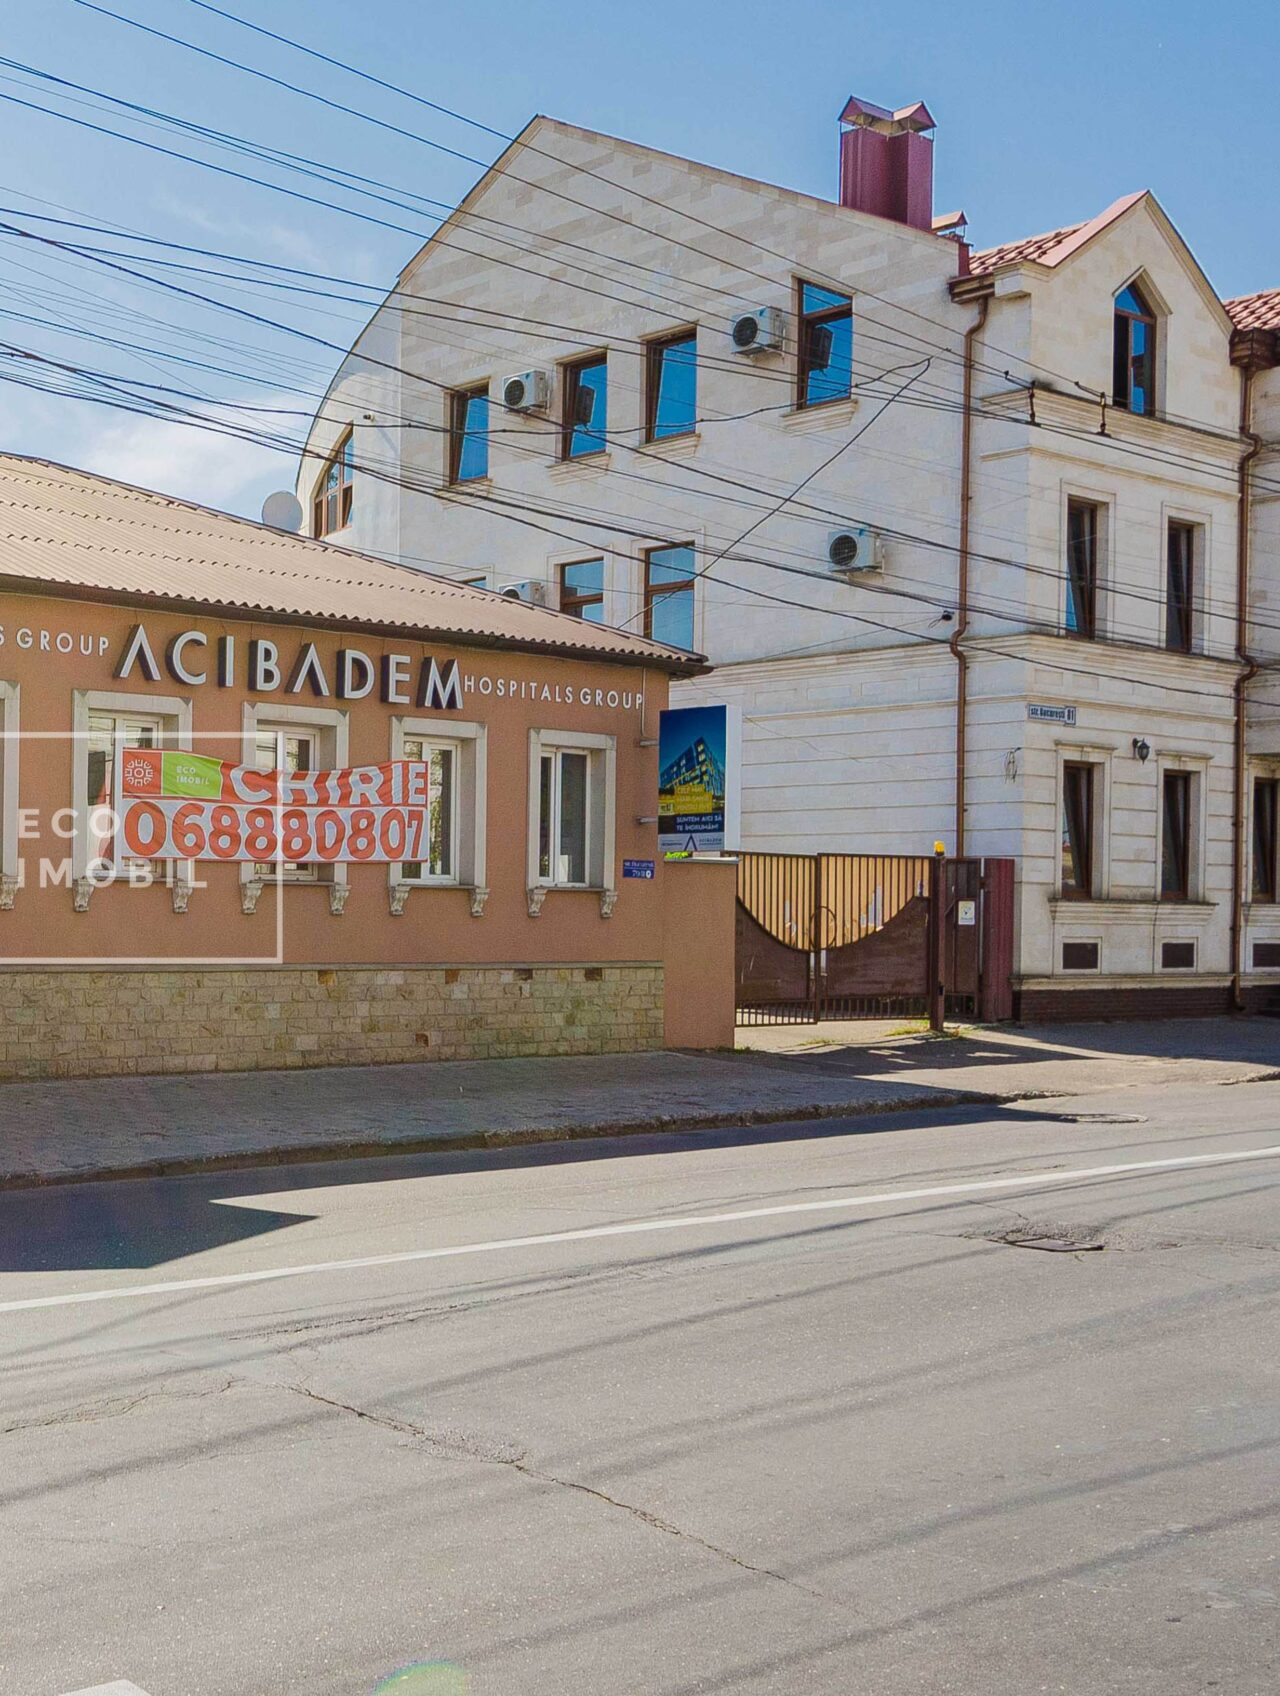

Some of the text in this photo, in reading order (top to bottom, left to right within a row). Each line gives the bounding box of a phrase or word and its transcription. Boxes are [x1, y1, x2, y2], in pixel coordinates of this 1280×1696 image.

[16, 627, 110, 657] GROUP
[117, 623, 464, 710] ACIBADEM
[464, 674, 644, 711] HOSPITALS GROUP
[176, 765, 197, 775] ECO
[176, 775, 210, 786] IMOBIL
[229, 762, 428, 804] CHIRIE
[123, 800, 425, 860] 068880807
